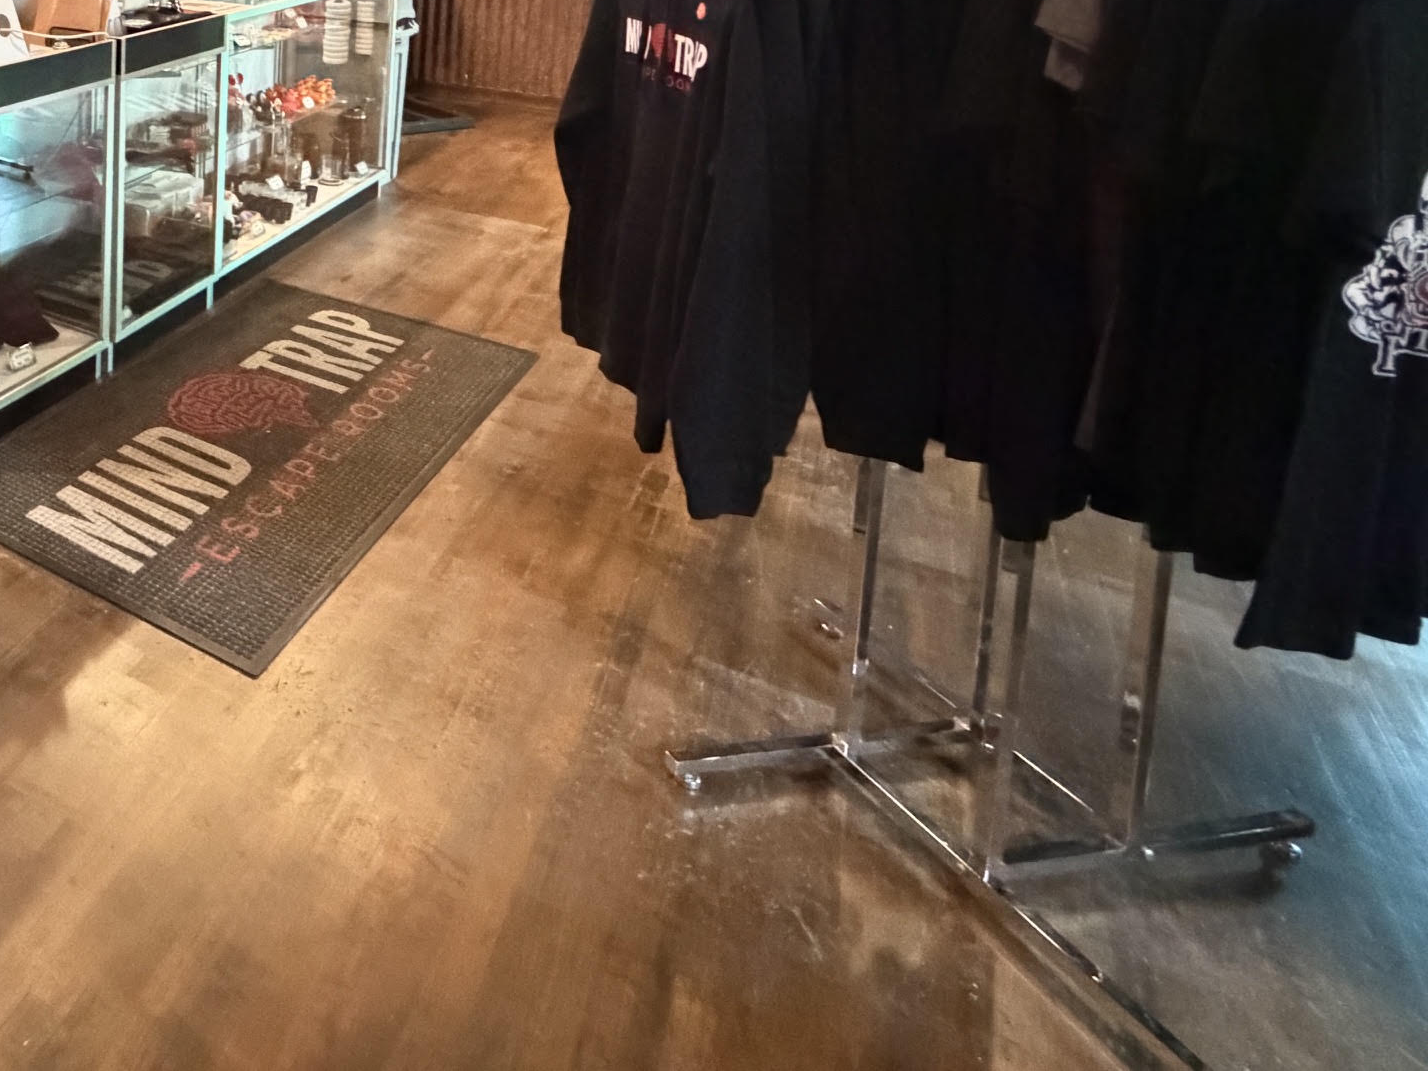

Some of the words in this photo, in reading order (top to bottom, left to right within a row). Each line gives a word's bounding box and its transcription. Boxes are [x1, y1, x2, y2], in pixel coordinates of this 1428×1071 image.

[674, 33, 708, 82] TRP
[25, 425, 253, 575] MIND
[239, 309, 406, 395] TRAP
[195, 438, 342, 564] ESCAPE
